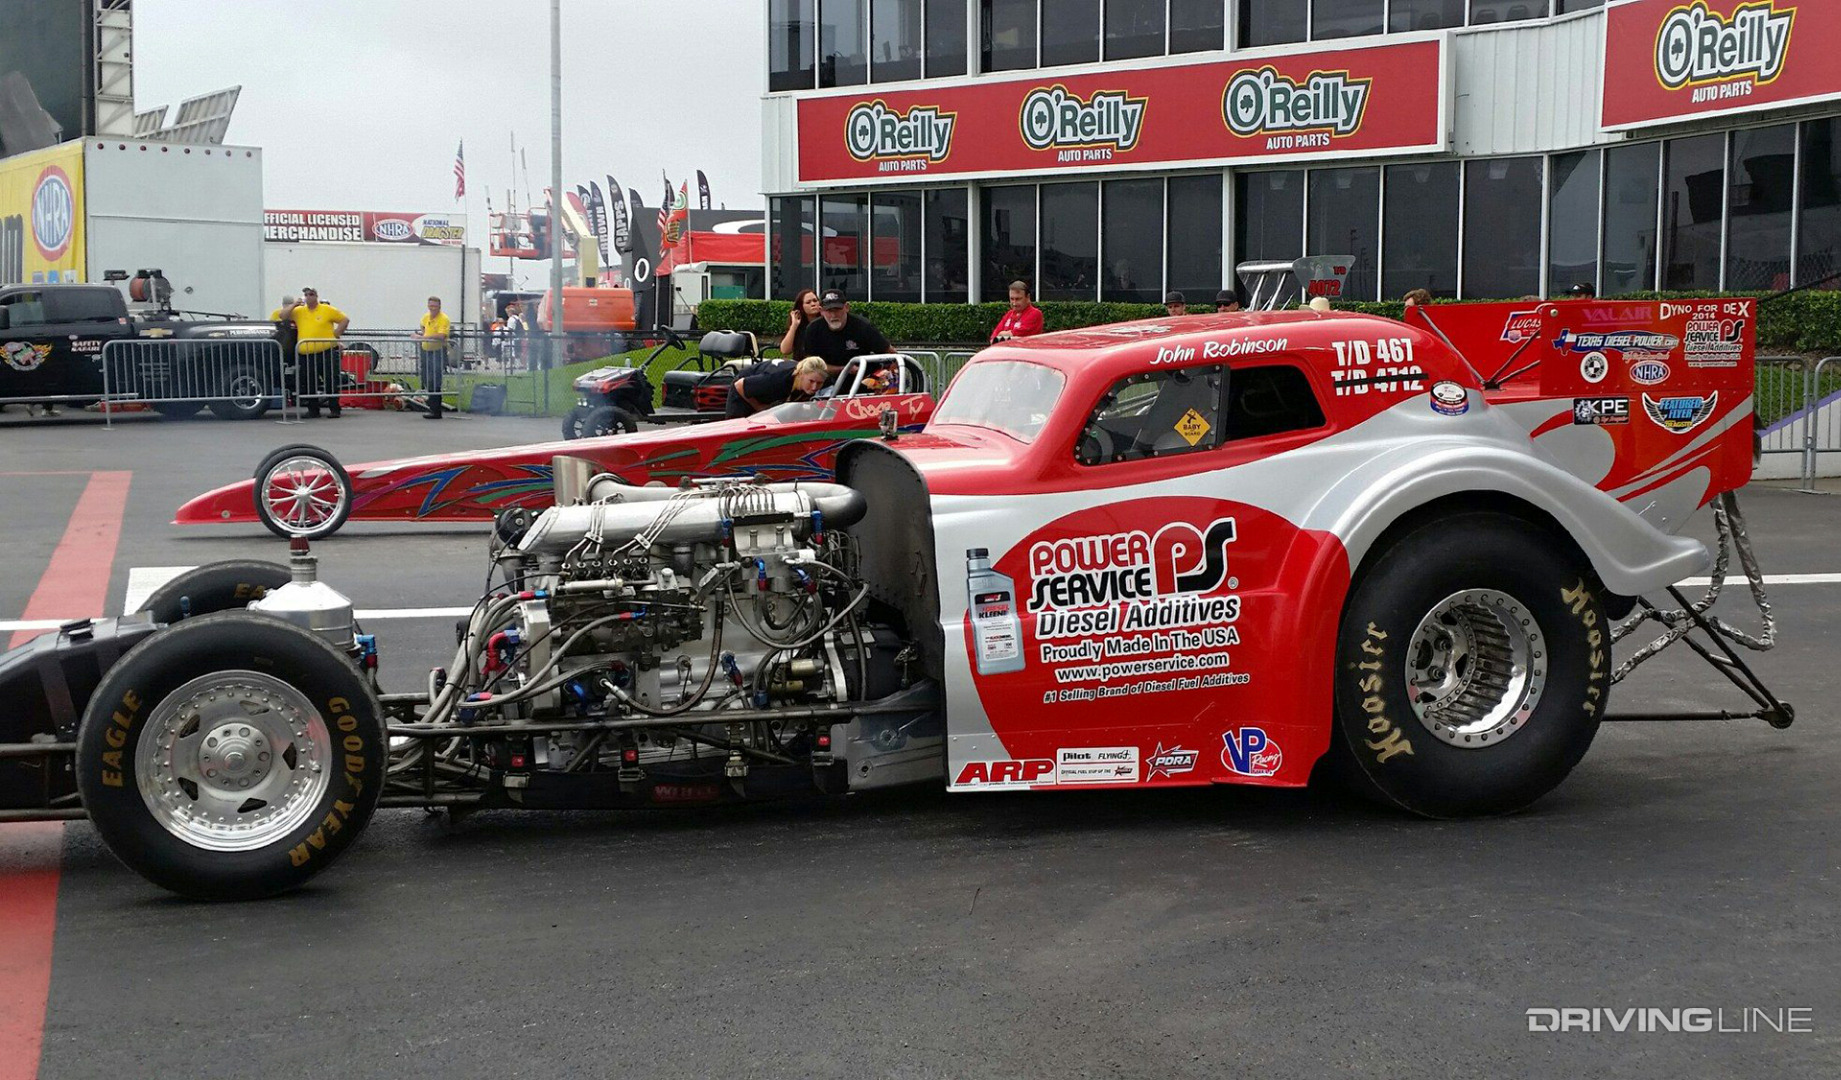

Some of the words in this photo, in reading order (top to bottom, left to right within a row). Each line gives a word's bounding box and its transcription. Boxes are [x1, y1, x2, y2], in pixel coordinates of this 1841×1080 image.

[1658, 7, 1791, 83] O'Reilly
[1224, 69, 1369, 134] O'Reilly
[1692, 88, 1717, 103] AUTO
[1720, 80, 1752, 99] PARTS
[1021, 87, 1147, 149] O'Reilly
[847, 101, 956, 161] O'Reilly
[1266, 135, 1293, 150] AUTO
[1296, 132, 1330, 148] PARTS
[878, 160, 899, 172] AUTO
[900, 158, 926, 171] PARTS
[1058, 149, 1081, 162] AUTO
[1084, 148, 1112, 161] PARTS
[36, 181, 69, 243] NHRA
[264, 212, 305, 226] FFICIAL
[308, 213, 360, 226] LICENSED
[376, 222, 409, 237] NHRA
[614, 200, 629, 248] CAPPS
[1581, 308, 1653, 322] VALAIR
[1697, 304, 1718, 312] FOR
[1510, 318, 1541, 330] LUCAS
[1686, 320, 1720, 332] POWER
[1577, 336, 1604, 347] TEXAS
[1604, 336, 1632, 346] DIESEL
[1684, 332, 1720, 342] SERVICE
[1150, 345, 1195, 365] John
[1203, 338, 1288, 360] Robinson
[1332, 340, 1371, 366] T/D
[1376, 338, 1413, 363] 467
[1374, 366, 1424, 393] 4712
[1635, 365, 1664, 380] NHRA
[1588, 400, 1628, 414] KPE
[1660, 398, 1702, 410] FEATURED
[1668, 408, 1693, 418] FLYER
[1031, 531, 1150, 577] POWER
[1028, 567, 1152, 611] SERVICE
[1037, 603, 1119, 638] Diesel
[1122, 596, 1240, 632] Additives
[1042, 643, 1102, 662] Proudly
[1106, 636, 1151, 656] Made
[1154, 635, 1169, 652] In
[1172, 632, 1202, 650] The
[1204, 628, 1239, 647] USA
[1056, 652, 1229, 682] www.powerservice.com
[1044, 690, 1058, 703] #1
[1060, 686, 1096, 703] Selling
[1098, 684, 1129, 699] Brand
[1131, 682, 1144, 696] of
[1144, 679, 1176, 694] Diesel
[1178, 677, 1200, 690] Fuel
[1202, 673, 1250, 688] Additives
[1352, 621, 1414, 763] Hoosier
[102, 689, 143, 788] EAGLE
[1222, 726, 1268, 774] VP
[1062, 752, 1092, 762] Pilot
[1155, 756, 1193, 766] PDRA
[1252, 752, 1281, 770] Racing
[955, 760, 1055, 784] ARP
